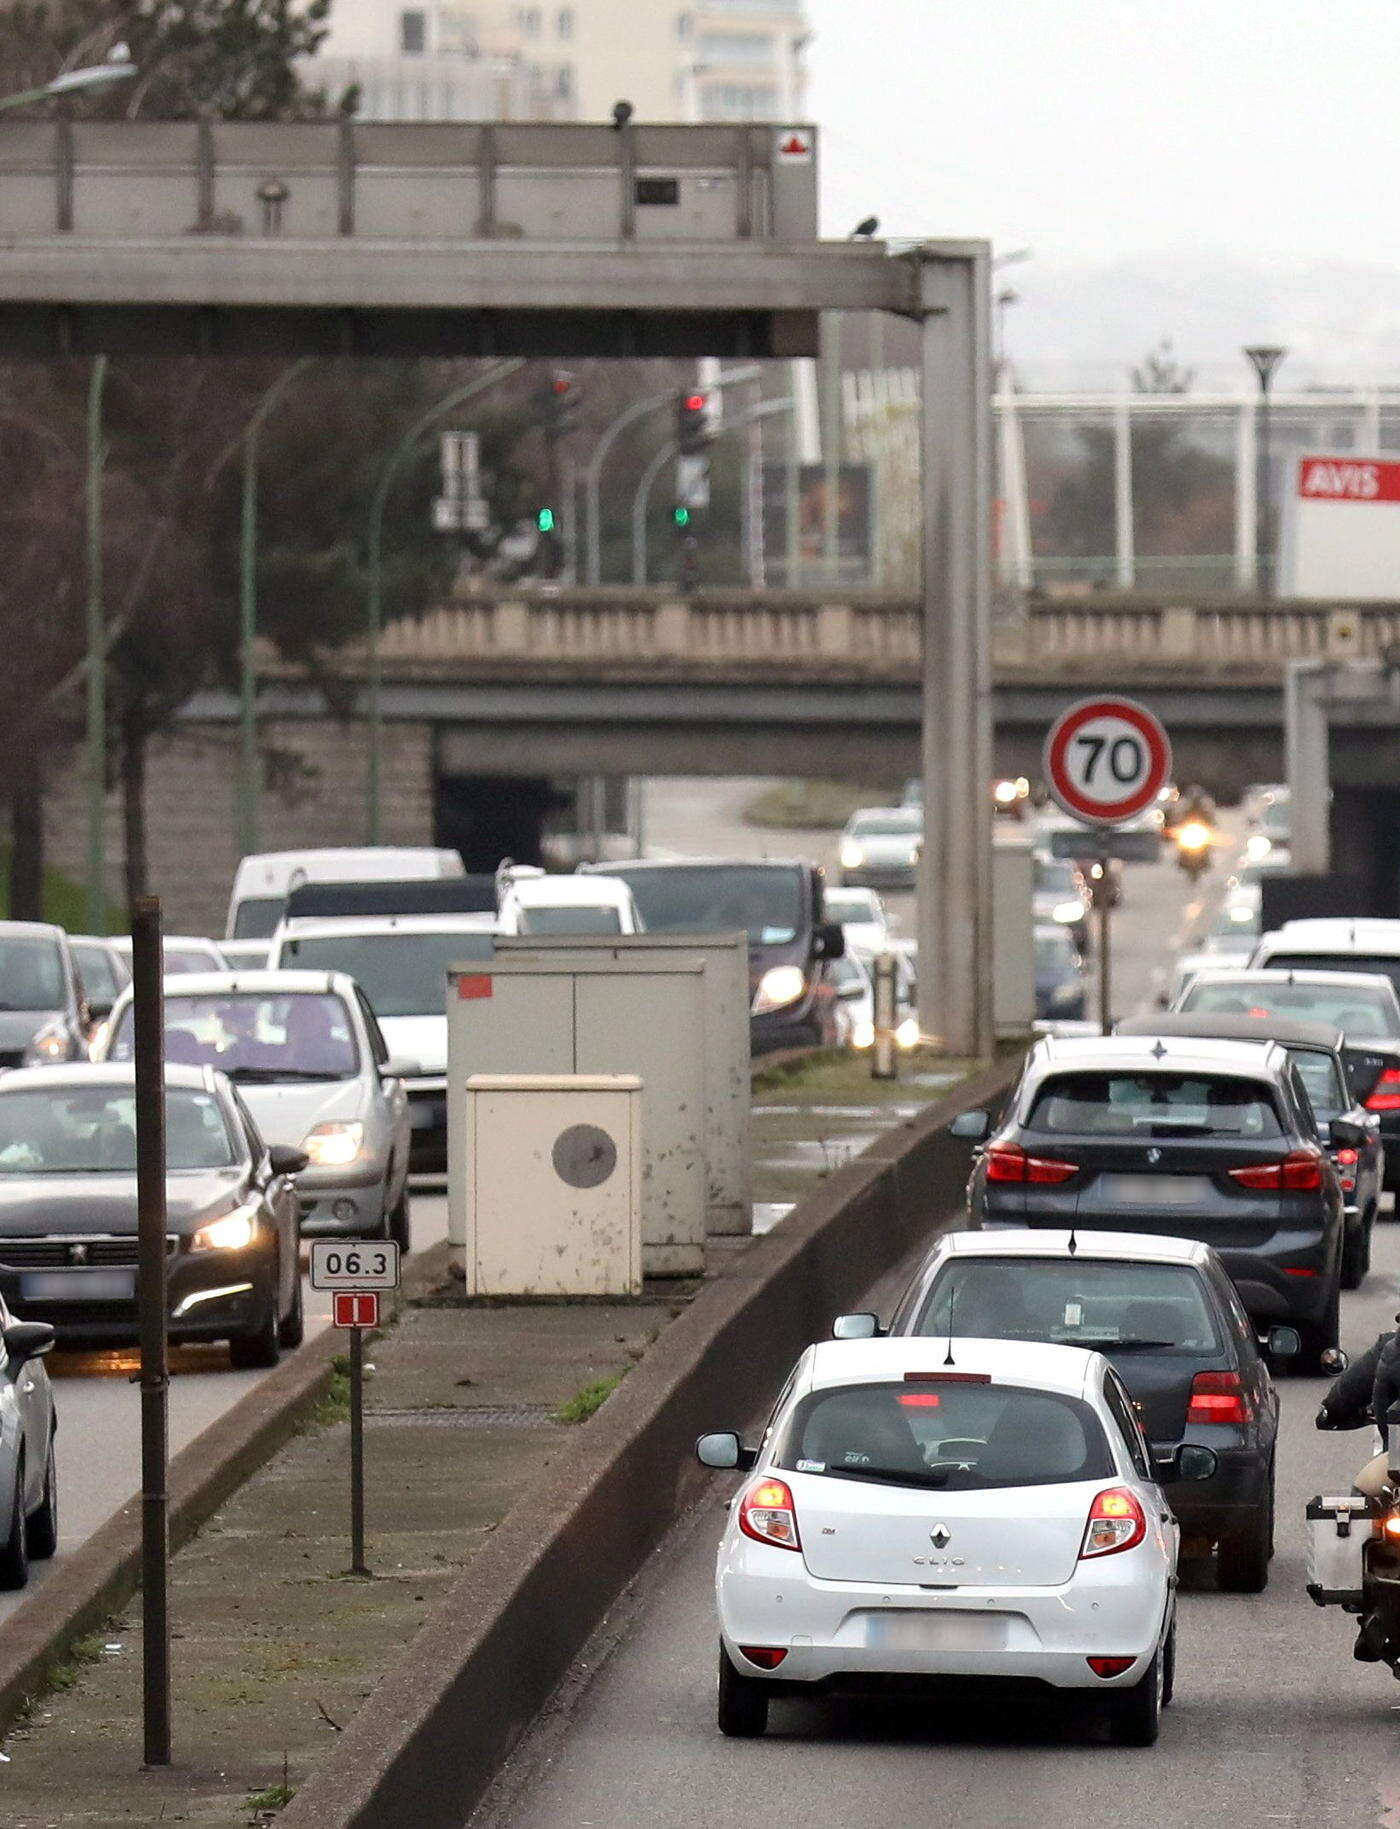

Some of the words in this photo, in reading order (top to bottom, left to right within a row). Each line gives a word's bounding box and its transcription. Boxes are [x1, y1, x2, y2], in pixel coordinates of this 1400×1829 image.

[1305, 464, 1378, 496] AVIS
[1077, 736, 1142, 785] 70
[326, 1253, 387, 1275] 06.3
[913, 1556, 965, 1566] CLIO
